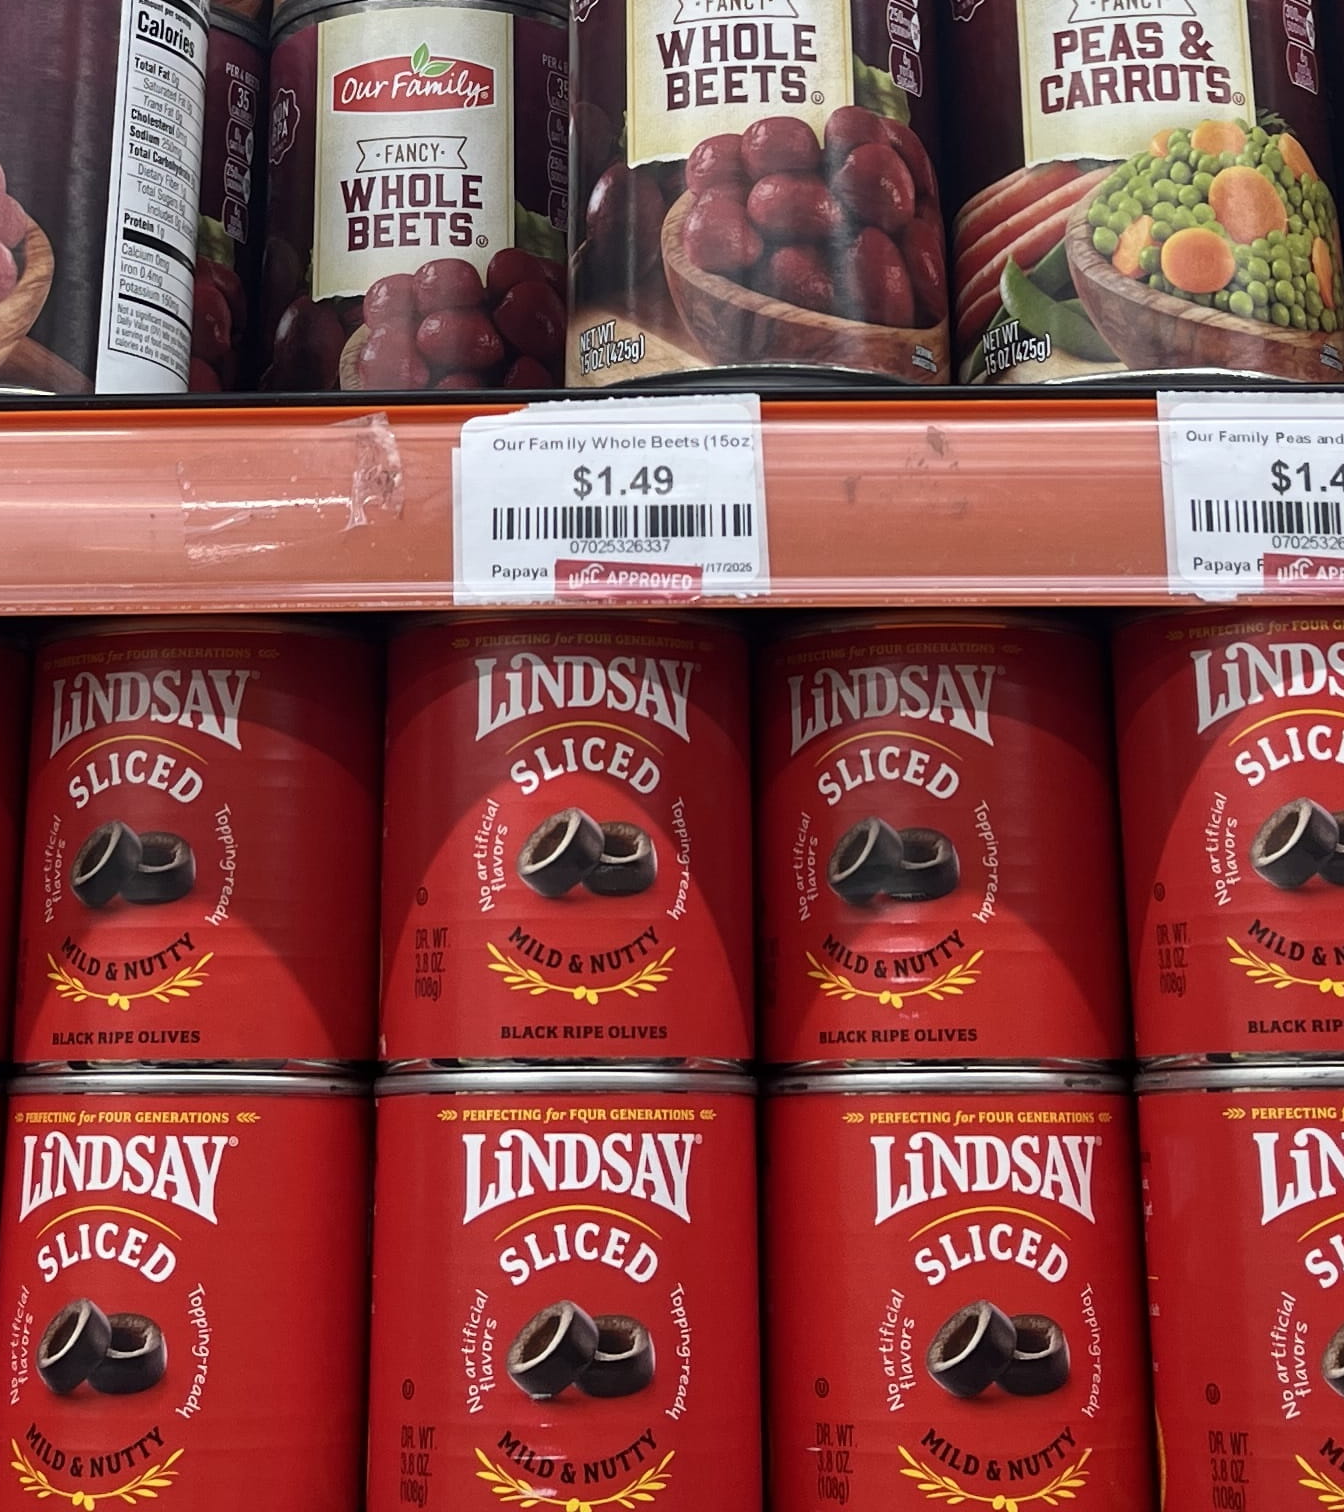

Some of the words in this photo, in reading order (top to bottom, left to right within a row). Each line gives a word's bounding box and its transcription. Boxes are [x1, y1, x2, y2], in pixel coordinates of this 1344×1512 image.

[138, 12, 195, 57] Calories
[129, 127, 160, 147] Sodium
[341, 175, 483, 213] WHOLE
[124, 213, 153, 231] Protein
[120, 279, 159, 303] Potassium
[493, 439, 525, 450] Our
[530, 437, 586, 452] Family
[592, 436, 646, 449] Whole
[651, 436, 699, 448] Beets
[704, 435, 754, 450] (15oz)
[1186, 431, 1213, 442] Our
[1219, 431, 1268, 445] Family
[1275, 433, 1311, 444] Peas
[1317, 434, 1344, 444] and
[573, 465, 673, 499] $1.49
[571, 539, 670, 553] 07025326337
[492, 564, 548, 580] Papaya
[1192, 558, 1250, 574] Papaya
[607, 571, 692, 589] APPROVED
[1205, 792, 1225, 873] artificial
[1247, 1019, 1307, 1034] BLACK
[463, 1110, 542, 1121] PERFECTING
[544, 1107, 566, 1123] for
[568, 1109, 607, 1121] FOUR
[610, 1110, 695, 1121] GENERATIONS
[497, 1430, 555, 1479] MILD
[561, 1457, 575, 1482] &
[584, 1426, 657, 1482] NUTTY
